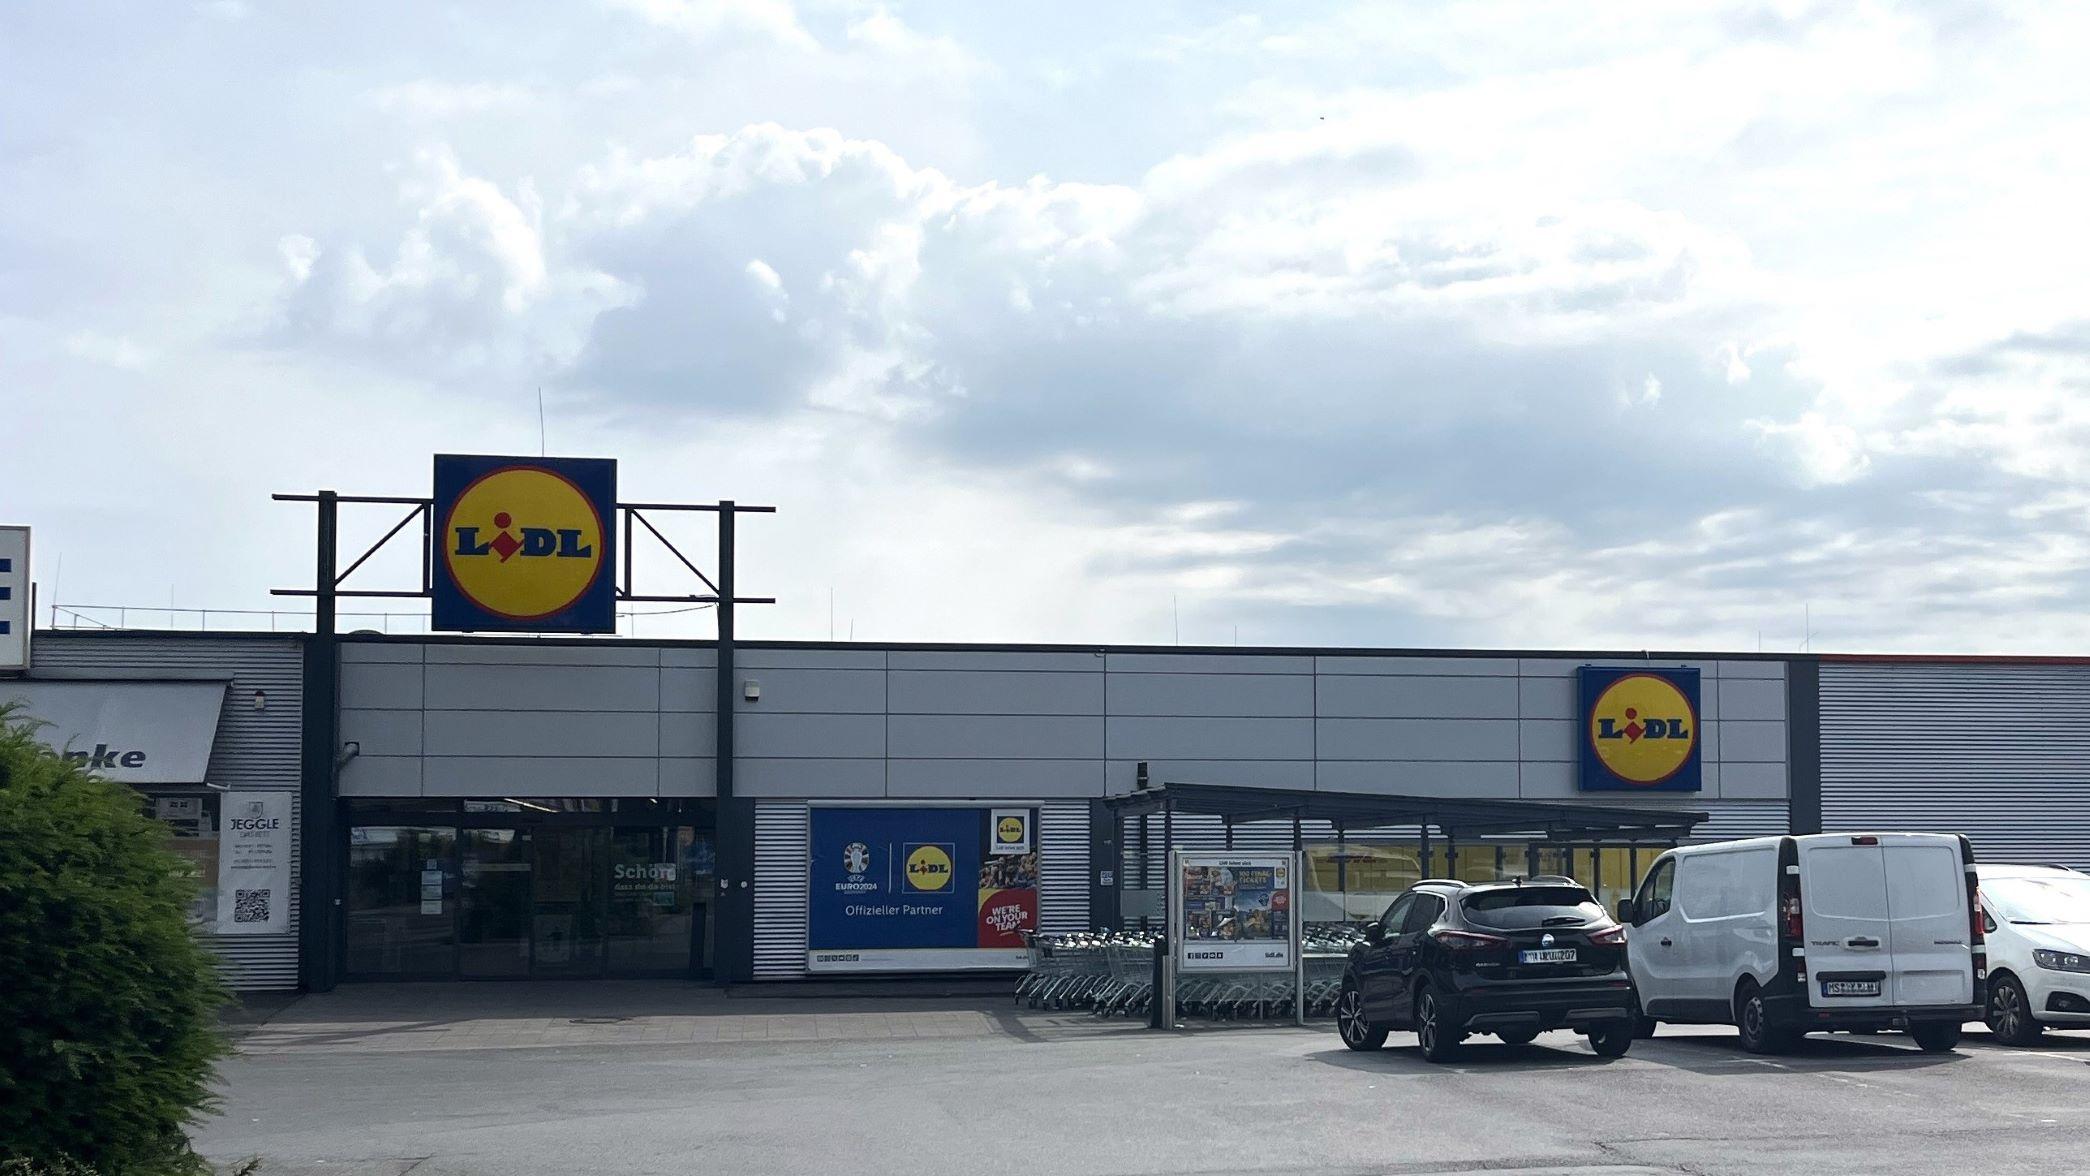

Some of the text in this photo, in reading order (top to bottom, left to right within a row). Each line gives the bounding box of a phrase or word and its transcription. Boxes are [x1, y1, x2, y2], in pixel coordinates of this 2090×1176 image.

[230, 818, 279, 831] JEGGLE
[845, 904, 943, 916] Offizieller Partner
[1001, 911, 1028, 925] YOUR
